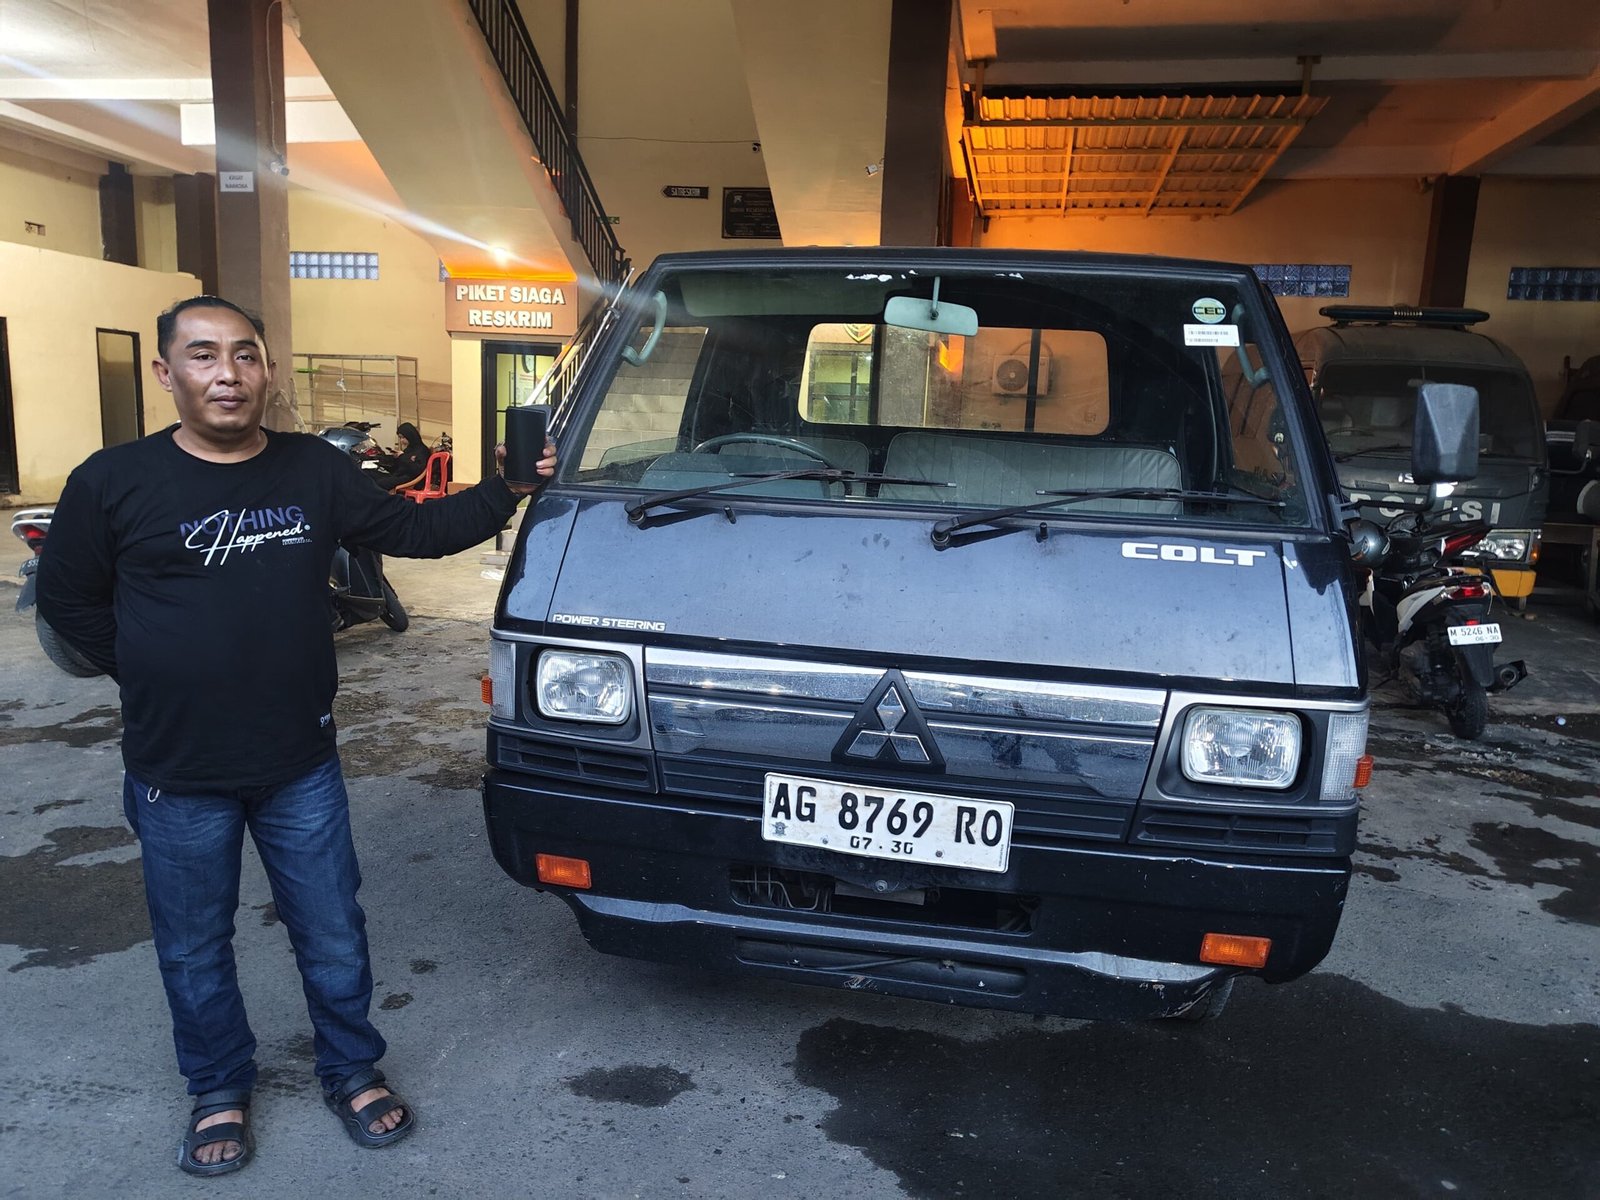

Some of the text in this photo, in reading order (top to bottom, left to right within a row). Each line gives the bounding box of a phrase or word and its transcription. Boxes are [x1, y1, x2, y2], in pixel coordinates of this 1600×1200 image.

[456, 284, 566, 305] PIKET SIAGA
[468, 309, 552, 328] RESKRIM
[1350, 492, 1501, 525] OISI
[180, 505, 305, 538] NOTHING
[1121, 541, 1267, 567] COLT
[552, 613, 666, 631] POWER STEERING
[1450, 629, 1457, 637] M
[1486, 626, 1499, 635] NA
[771, 782, 817, 823] AG
[838, 791, 936, 839] 8769
[954, 805, 1003, 848] RO
